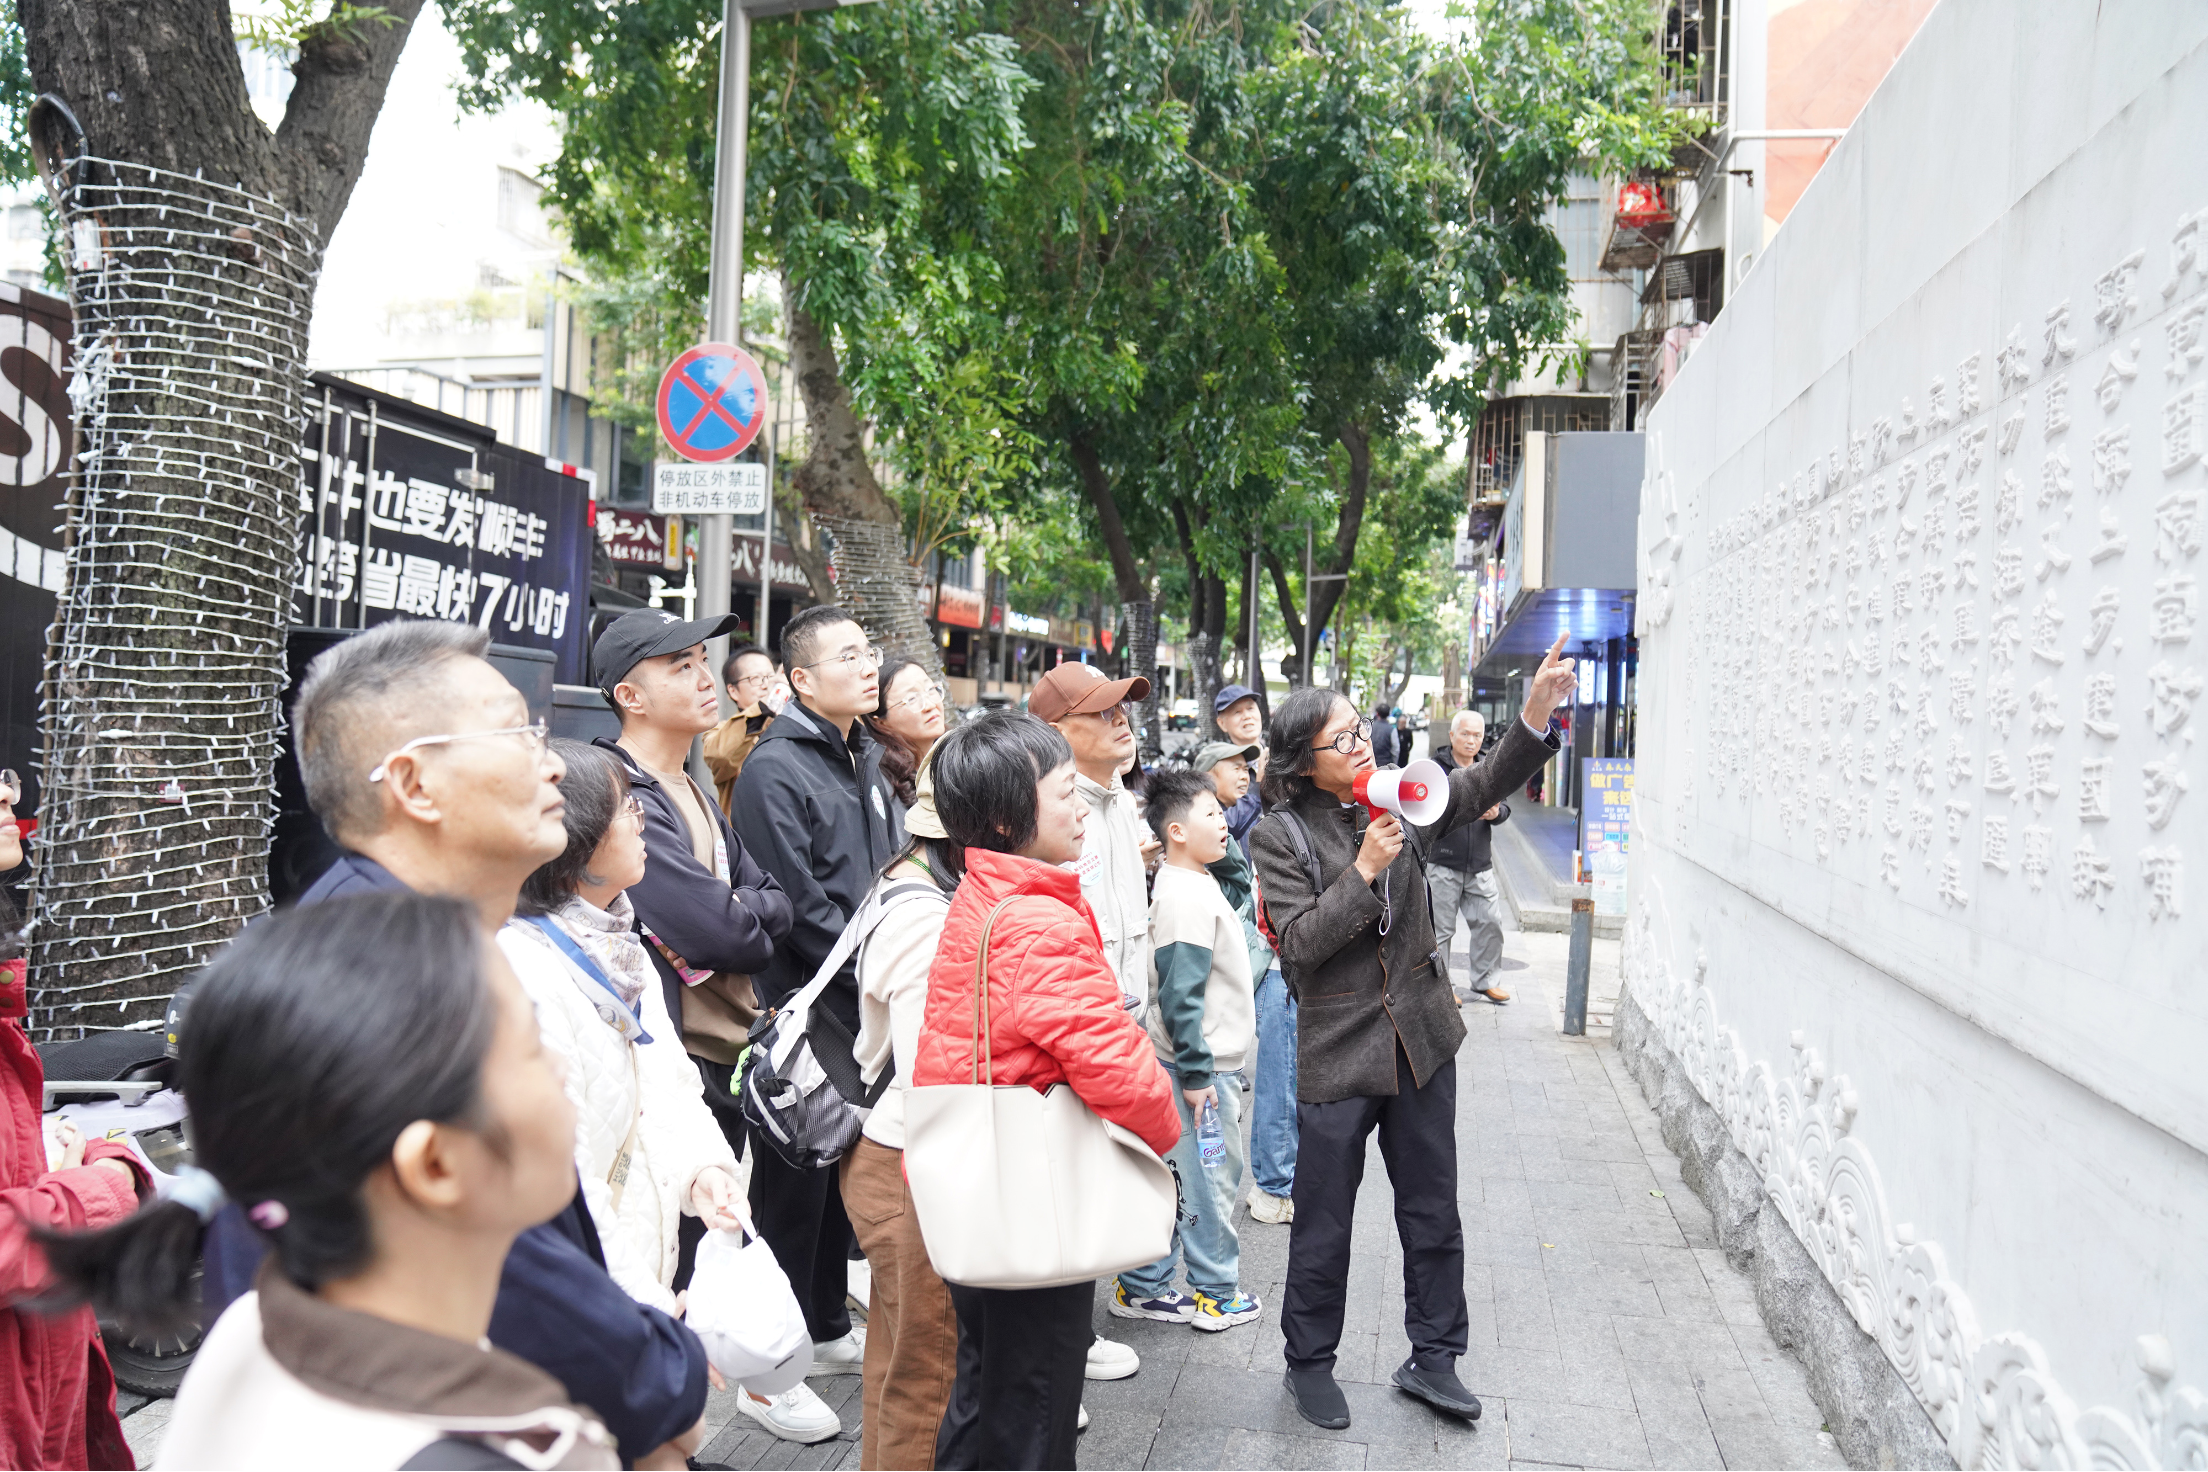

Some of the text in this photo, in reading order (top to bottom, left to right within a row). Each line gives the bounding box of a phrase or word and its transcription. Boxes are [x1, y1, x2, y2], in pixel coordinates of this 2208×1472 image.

[301, 447, 547, 562] 件也要发顺丰
[659, 491, 760, 509] 非机动车停放
[660, 470, 761, 487] 停放区外禁止
[303, 533, 570, 639] 跨省最快7小时
